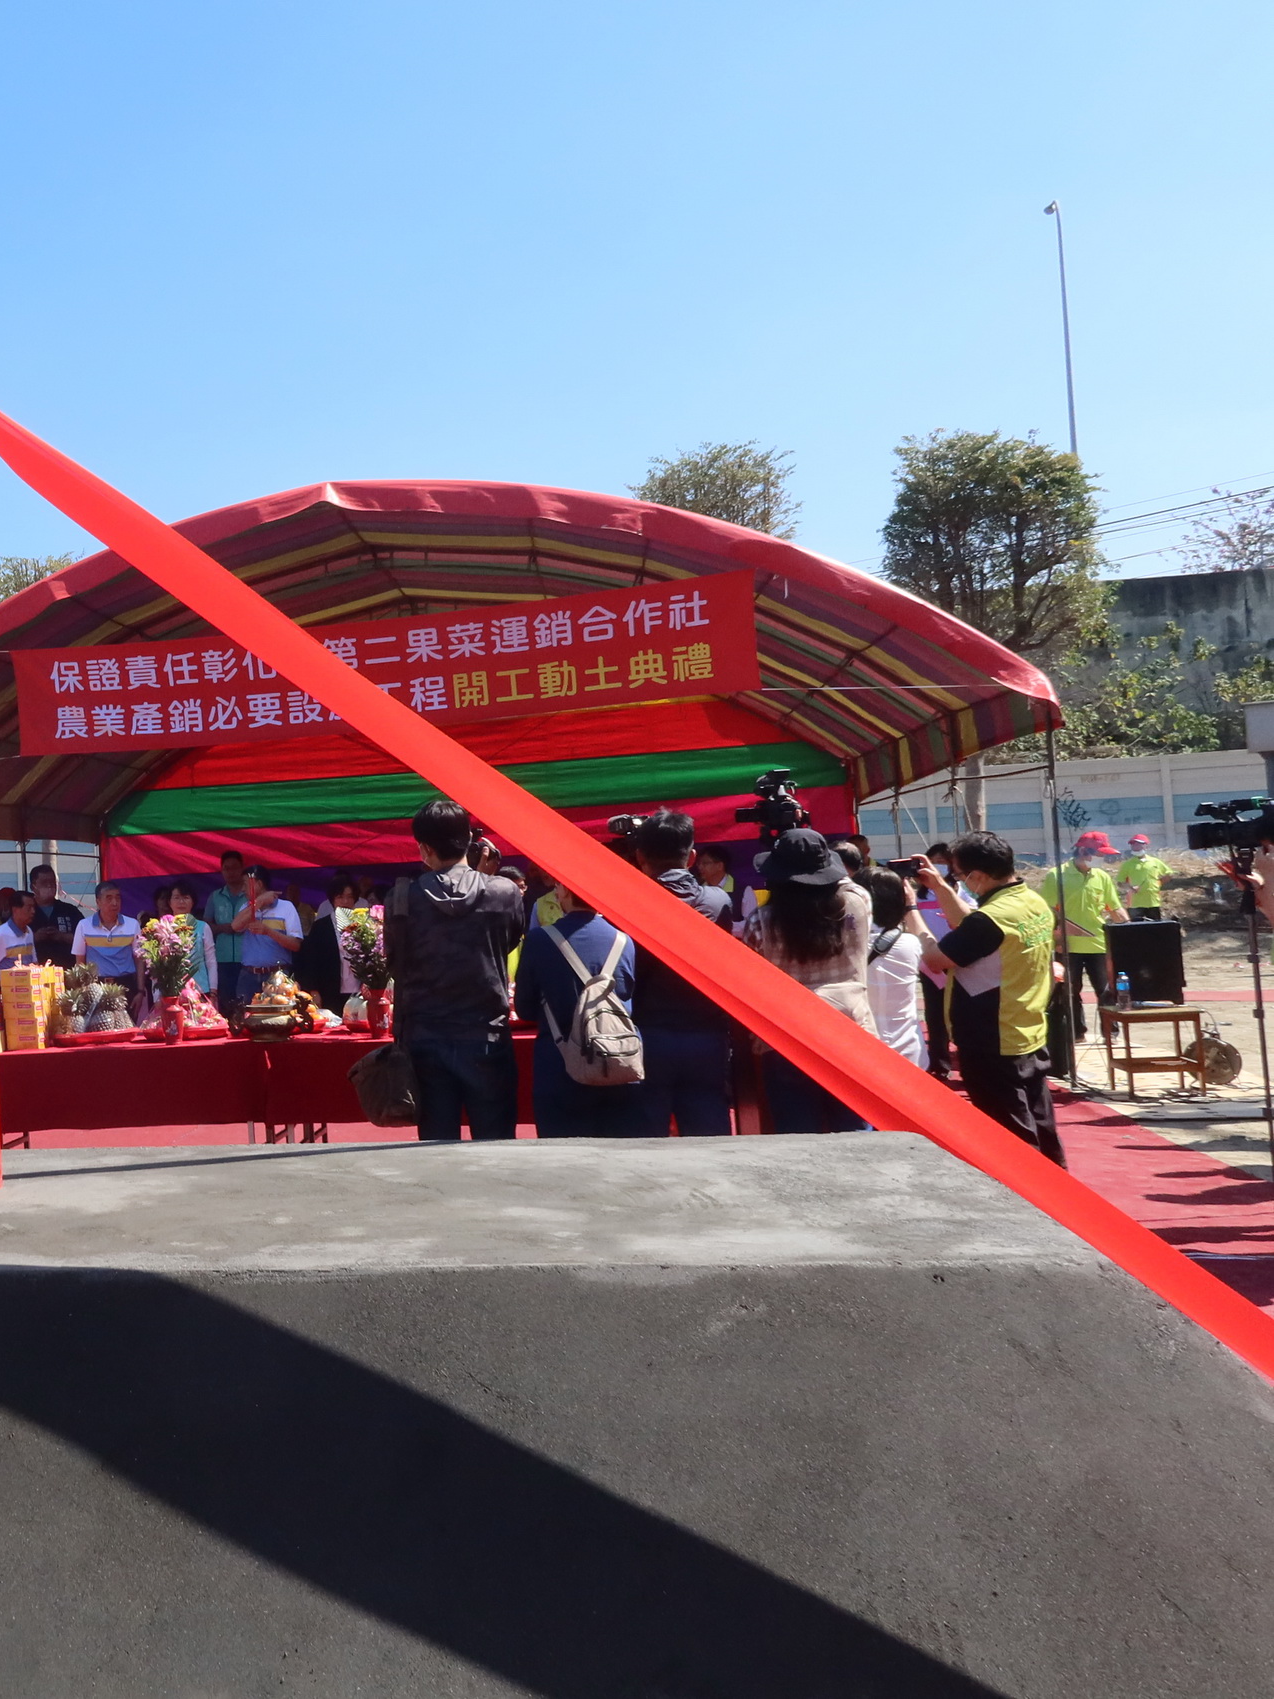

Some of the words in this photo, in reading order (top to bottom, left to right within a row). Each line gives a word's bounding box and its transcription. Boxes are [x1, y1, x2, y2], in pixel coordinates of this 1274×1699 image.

[50, 590, 710, 694] 保證責任彰化第二果菜運銷合作社
[55, 642, 714, 739] 農業產銷必要設程開工動土典禮
